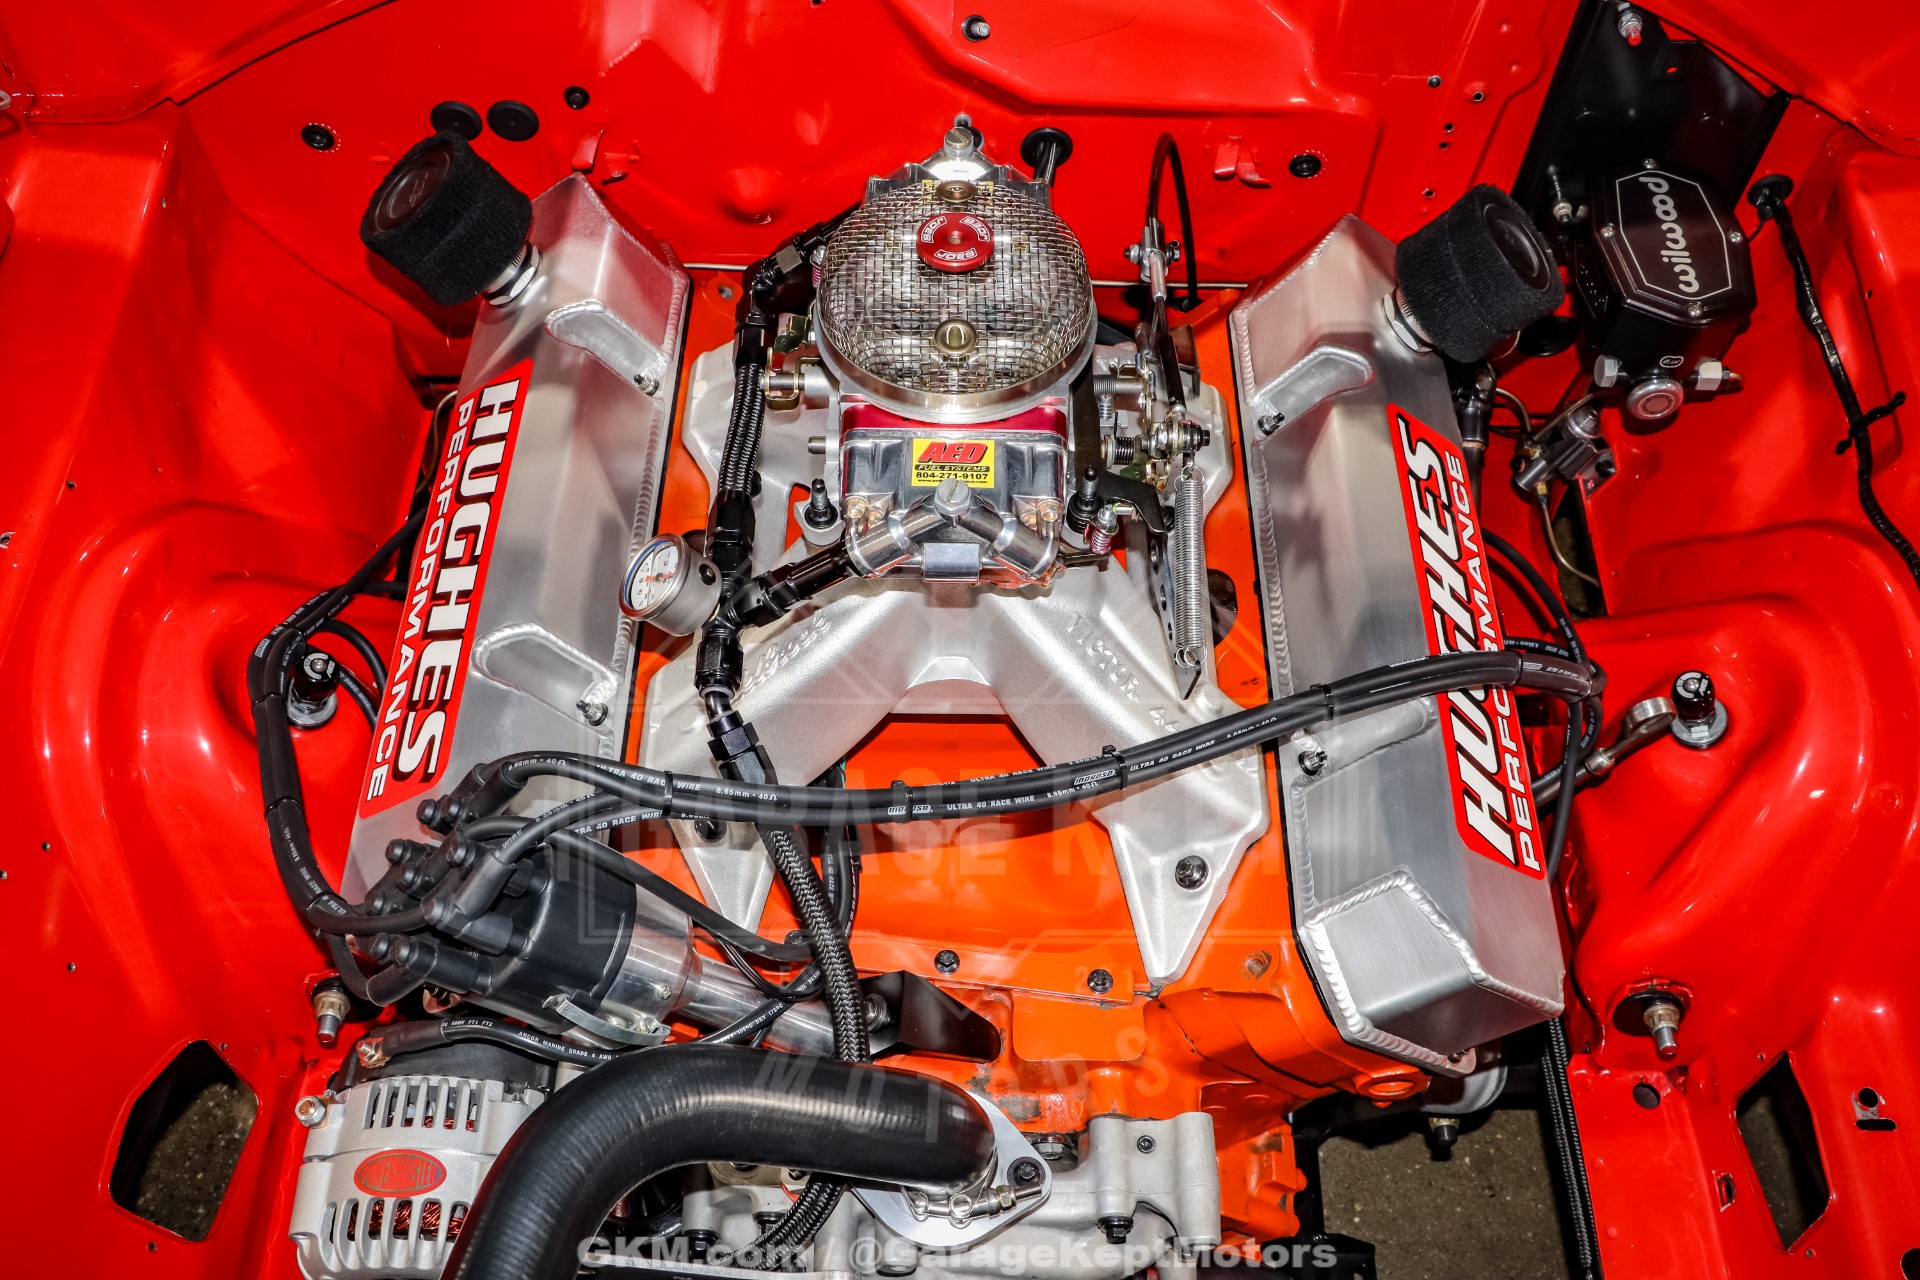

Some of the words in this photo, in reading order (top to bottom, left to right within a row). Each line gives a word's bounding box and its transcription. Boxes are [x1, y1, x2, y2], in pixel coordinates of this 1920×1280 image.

[1638, 176, 1700, 293] wilwood
[917, 442, 988, 463] AED
[915, 471, 989, 480] 804-271-9107
[918, 464, 941, 472] FUEL
[943, 465, 987, 473] SYSTEMS
[395, 379, 520, 778] HUGHES
[367, 397, 475, 802] PERFORMANCE
[1397, 416, 1518, 868] HUGHES
[1129, 760, 1155, 772] ULTRA
[1158, 756, 1169, 764] 40
[1172, 748, 1193, 760] RACE
[630, 772, 644, 781] 40
[647, 777, 666, 787] RAC
[677, 781, 702, 792] WIRE
[716, 787, 750, 798] 8.65mm
[947, 803, 973, 811] ULTRA
[976, 801, 987, 809] 40
[990, 799, 1011, 808] RACE
[1014, 795, 1035, 805] WIRE
[574, 825, 593, 835] TRA
[596, 821, 608, 830] 40
[612, 815, 637, 827] RACE
[641, 810, 662, 820] WIR
[518, 1031, 540, 1043] ANCOR
[543, 1040, 566, 1053] MARINE
[568, 1048, 588, 1058] GRADE
